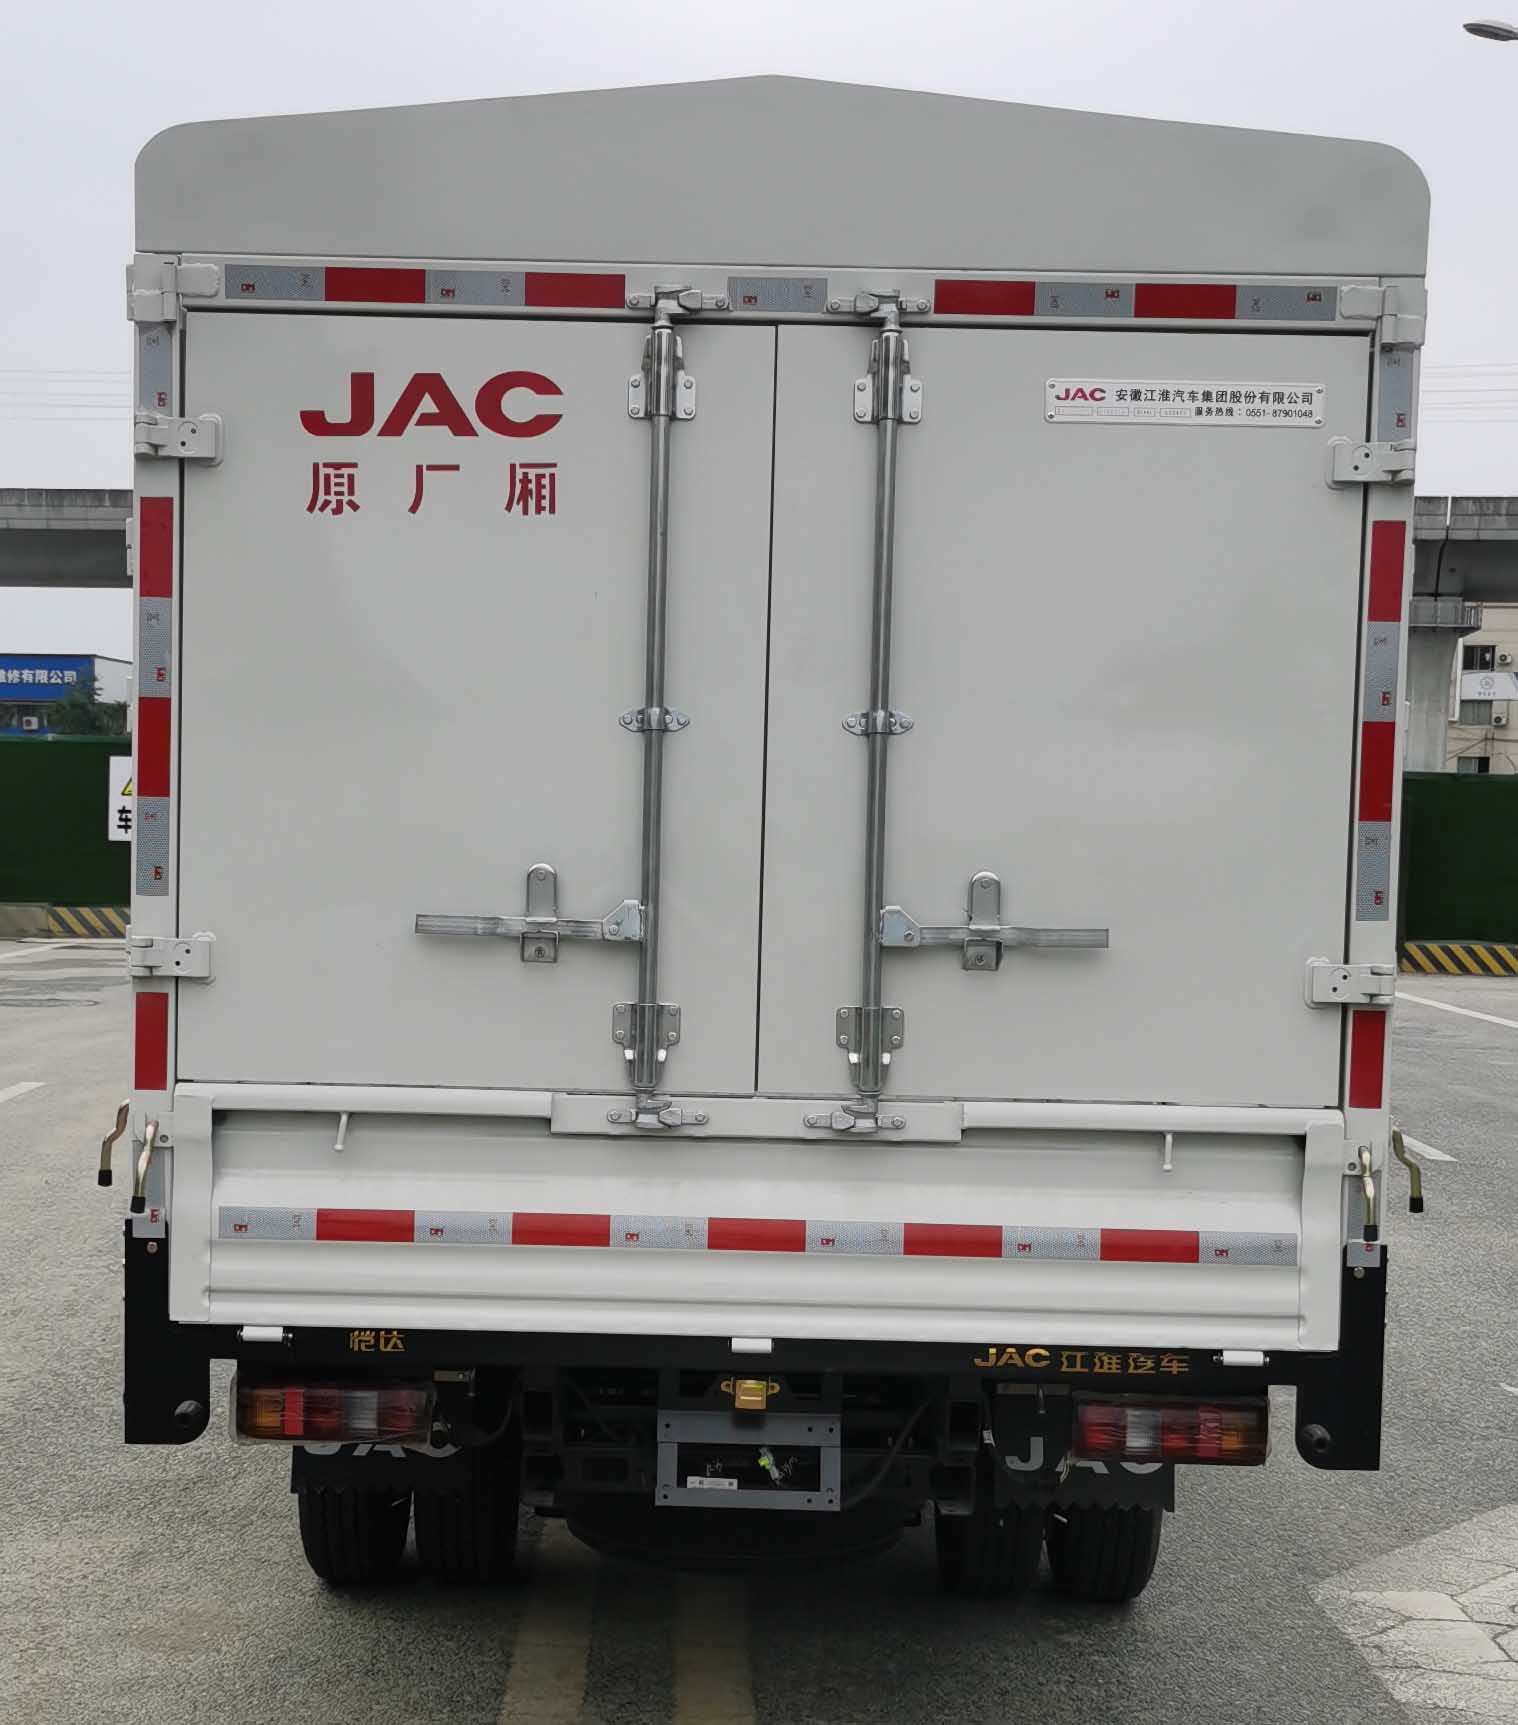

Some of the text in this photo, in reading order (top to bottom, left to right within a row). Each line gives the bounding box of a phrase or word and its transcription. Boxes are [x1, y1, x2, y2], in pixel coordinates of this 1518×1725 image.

[299, 371, 564, 438] JAC
[1055, 387, 1313, 406] JAC 安徽江淮汽车集团股份有限公司
[974, 1347, 1190, 1374] JAC 江淮汽车
